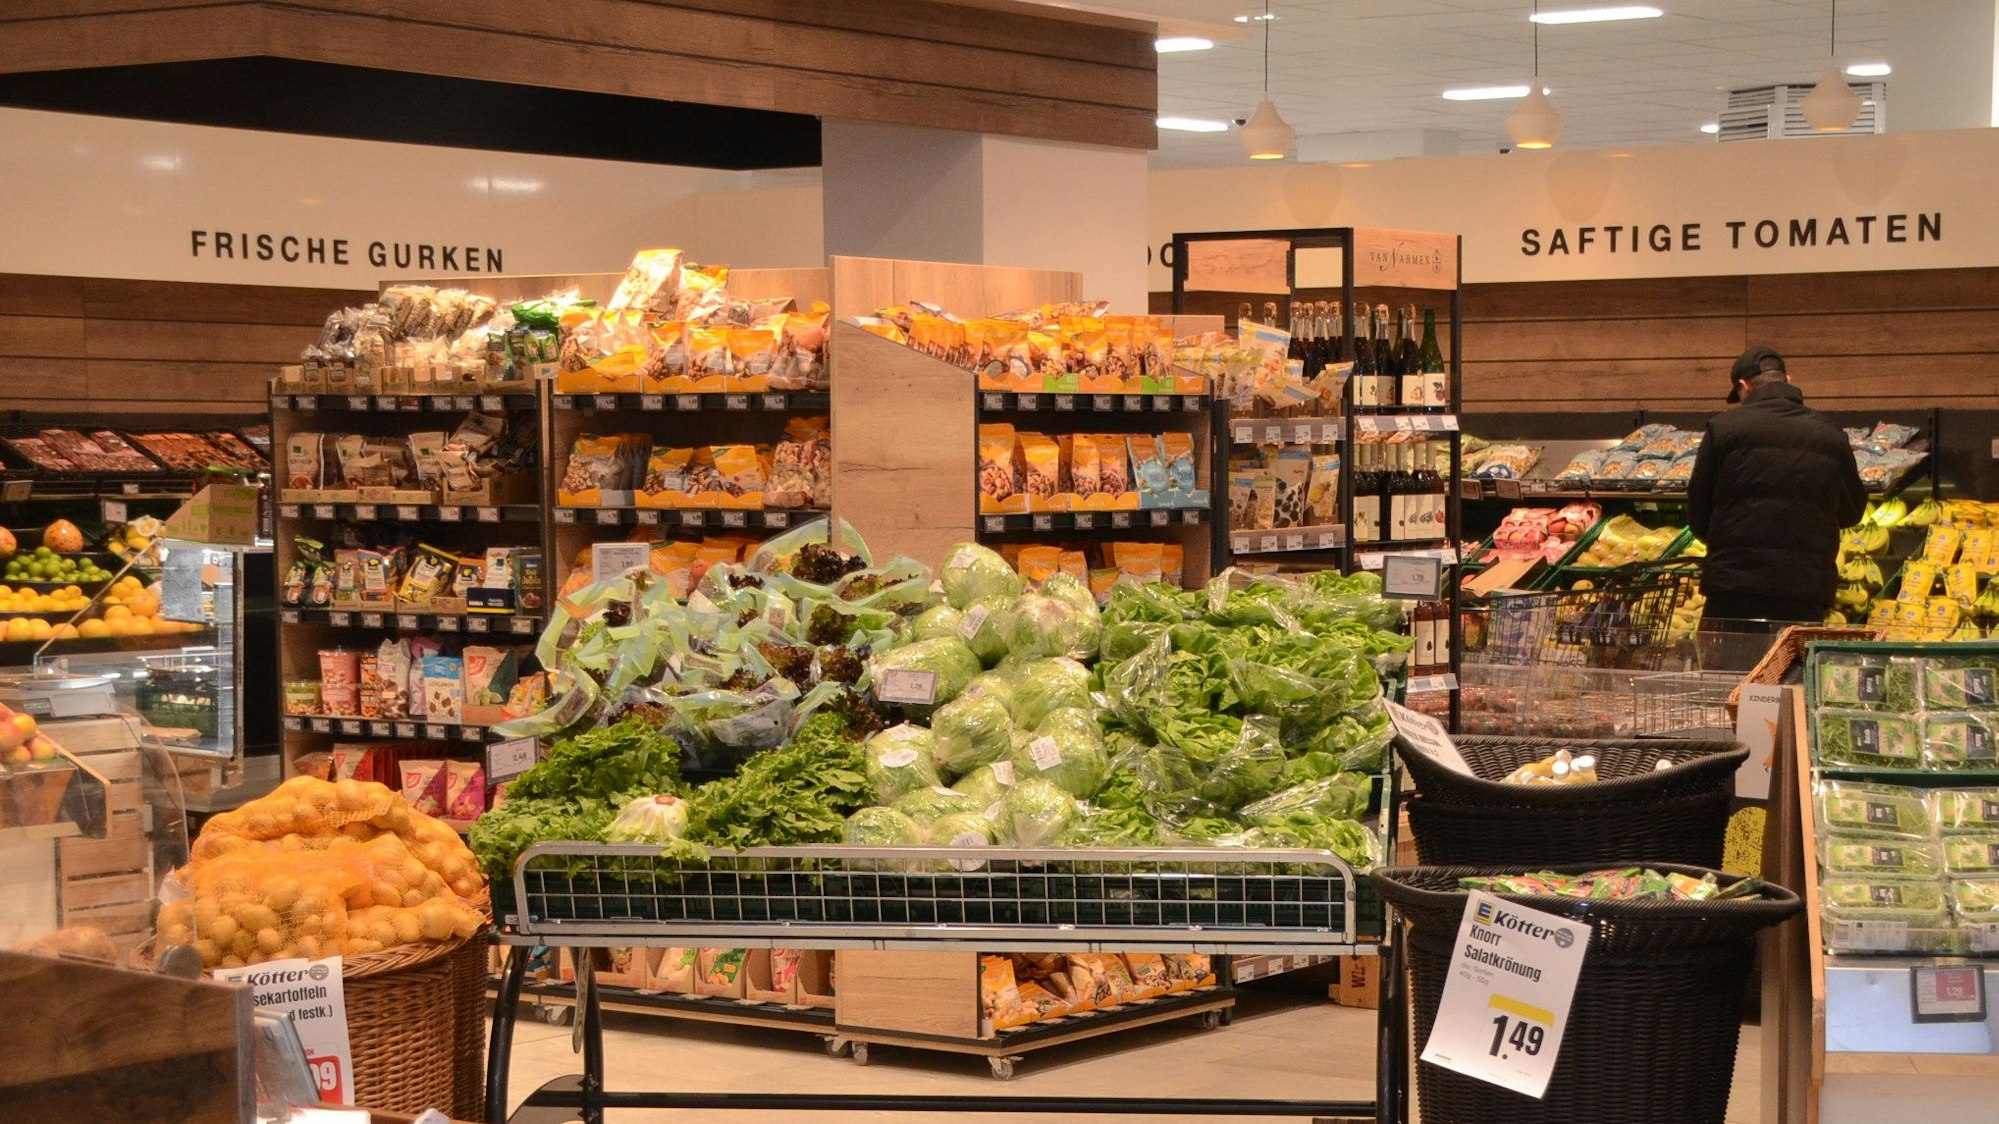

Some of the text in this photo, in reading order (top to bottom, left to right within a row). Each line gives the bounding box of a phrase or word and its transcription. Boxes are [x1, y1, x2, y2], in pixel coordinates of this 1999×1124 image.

[1521, 212, 1942, 257] SAFTIGE TOMATEN
[191, 230, 504, 273] FRISCHE GURKEN
[1369, 251, 1388, 263] VAN
[1469, 924, 1502, 946] Knorr
[1494, 910, 1554, 940] Kötter
[247, 969, 309, 986] Kötter
[1464, 944, 1541, 982] Salatkrönung
[253, 985, 327, 1007] sekartoffeln
[1489, 1015, 1544, 1060] 1.49
